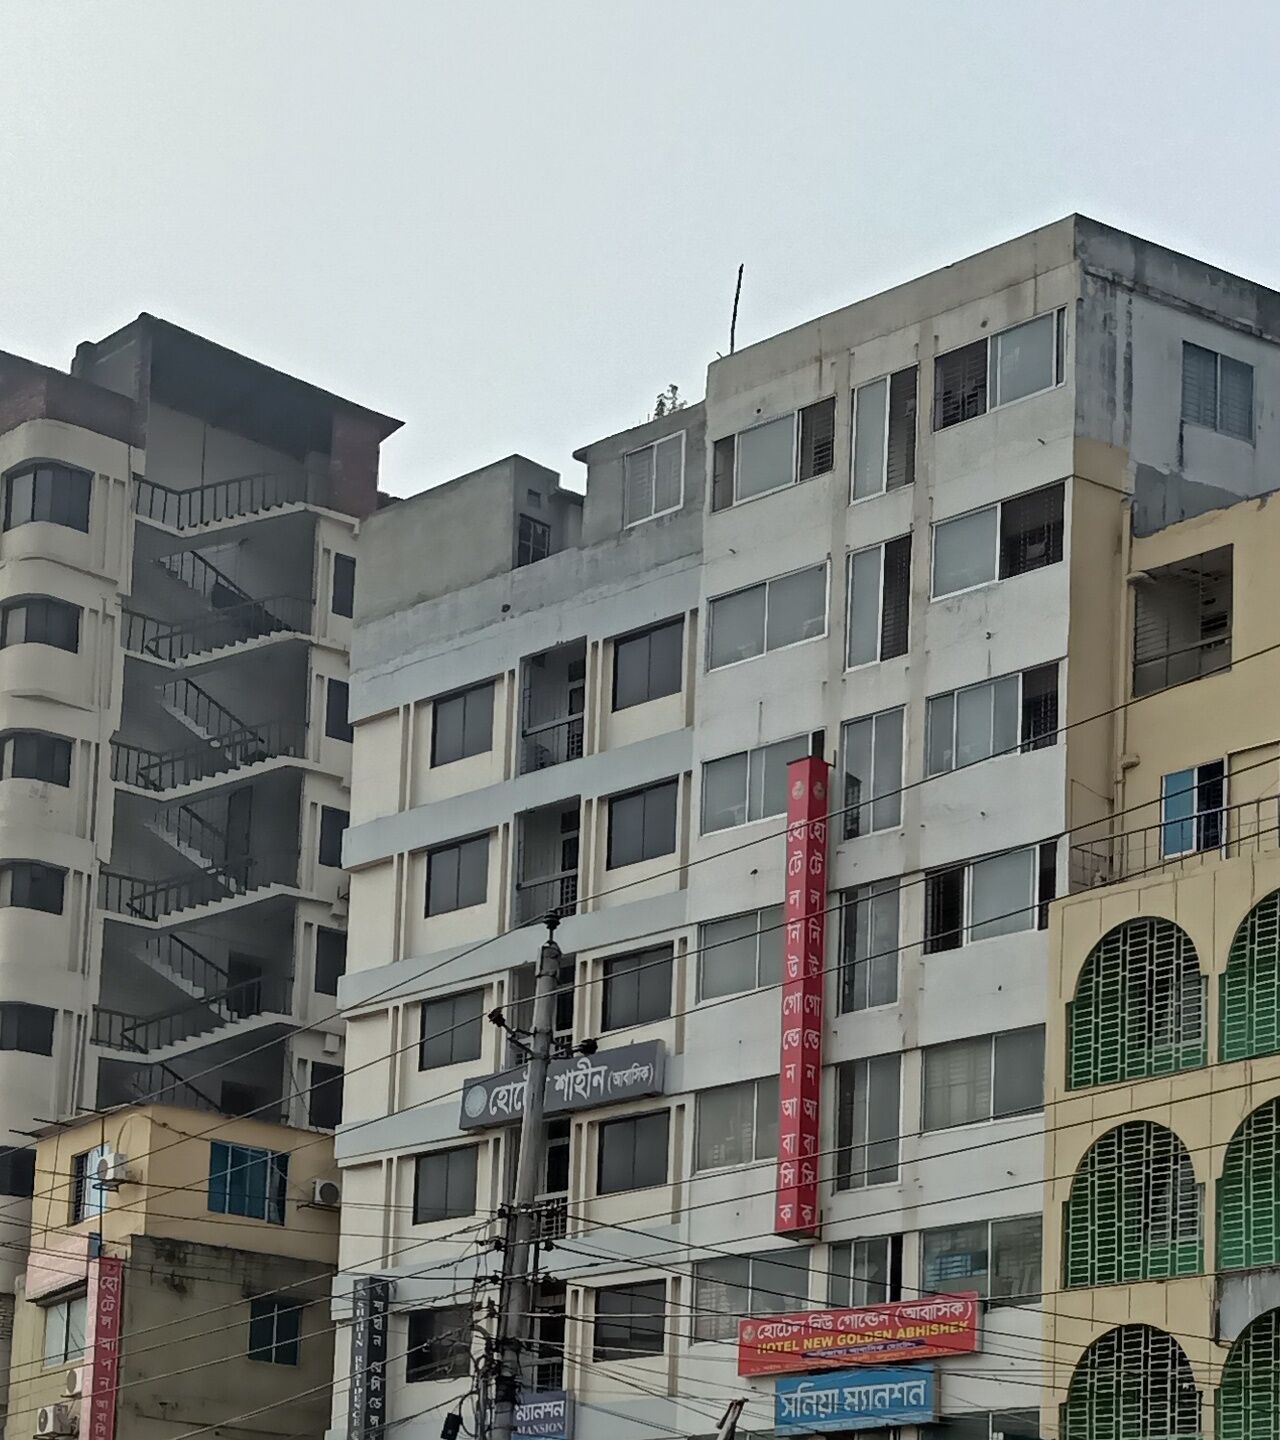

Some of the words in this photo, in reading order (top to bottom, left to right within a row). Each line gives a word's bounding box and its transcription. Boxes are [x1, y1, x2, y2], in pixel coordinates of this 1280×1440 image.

[554, 1057, 608, 1101] শাহীন
[757, 1318, 807, 1340] হোটেল
[757, 1340, 800, 1354] HOTEL
[803, 1335, 834, 1350] NEW
[837, 1330, 893, 1346] GOLDEN
[896, 1320, 970, 1340] ABHISHEK
[779, 1382, 840, 1418] সনিয়া
[842, 1379, 927, 1412] ম্যানশন
[516, 1422, 563, 1435] MANSION
